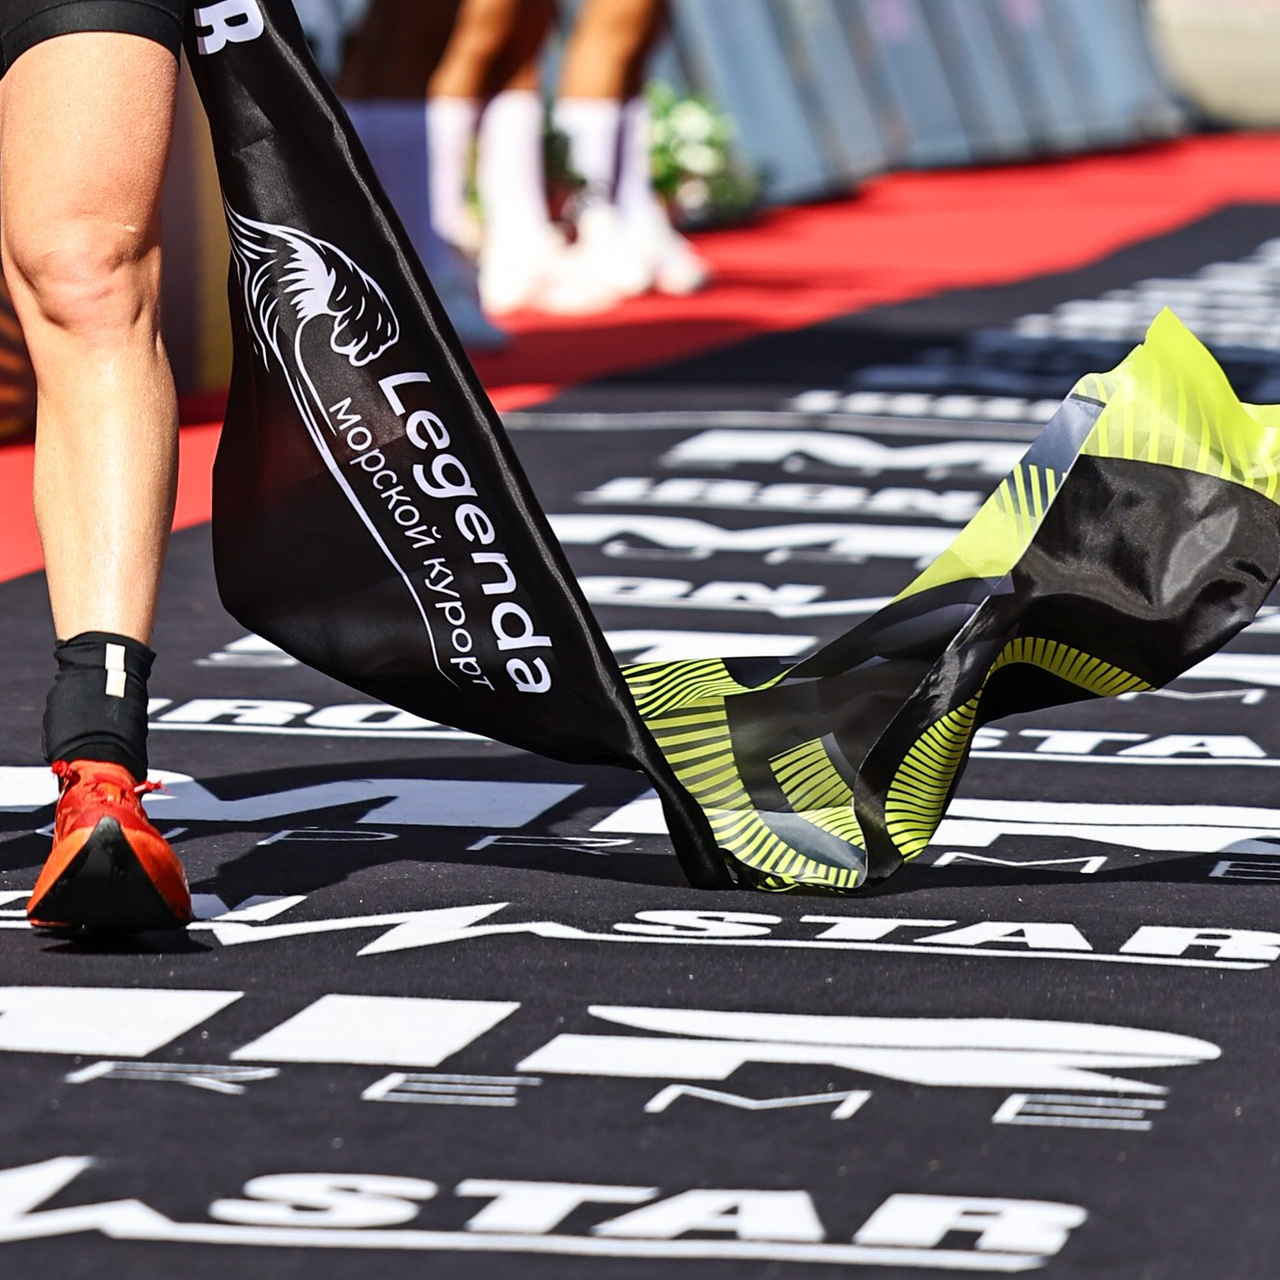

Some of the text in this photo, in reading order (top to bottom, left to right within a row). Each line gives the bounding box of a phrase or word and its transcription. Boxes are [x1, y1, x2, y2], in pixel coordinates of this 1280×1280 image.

[328, 396, 496, 691] морской курорт
[377, 371, 553, 694] Legenda
